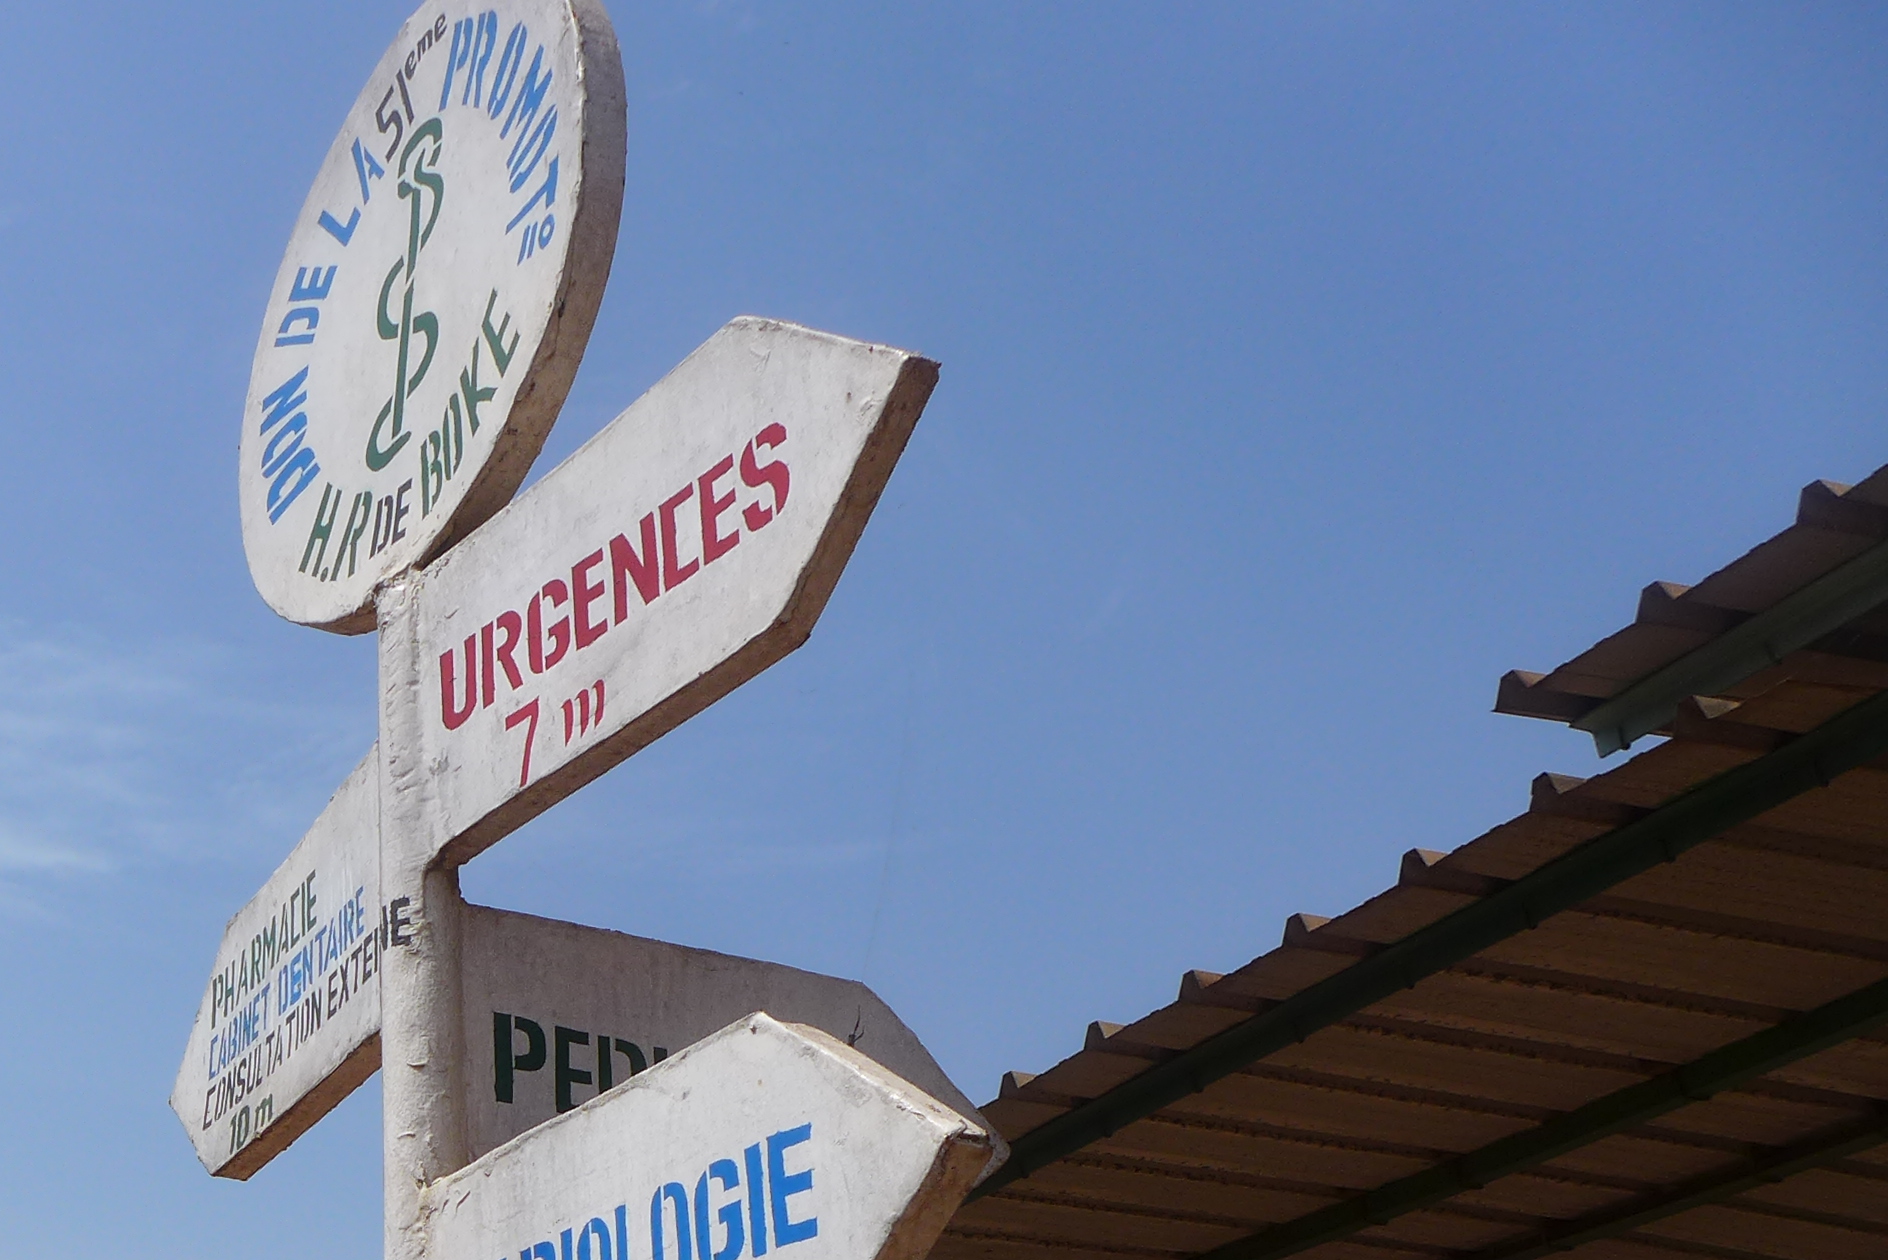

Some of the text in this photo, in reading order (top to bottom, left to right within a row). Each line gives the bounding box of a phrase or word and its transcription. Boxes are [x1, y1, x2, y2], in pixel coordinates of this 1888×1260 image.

[274, 265, 338, 347] DE
[260, 364, 321, 525] DON
[369, 478, 412, 560] DE
[420, 286, 520, 520] BOKE
[439, 422, 790, 731] URGENCES
[505, 695, 539, 788] 7
[208, 885, 364, 1081] CABINET DENTAIRE
[211, 869, 317, 1030] PHARMACIE
[202, 985, 321, 1131] CONSULTATION
[229, 1104, 250, 1155] 10
